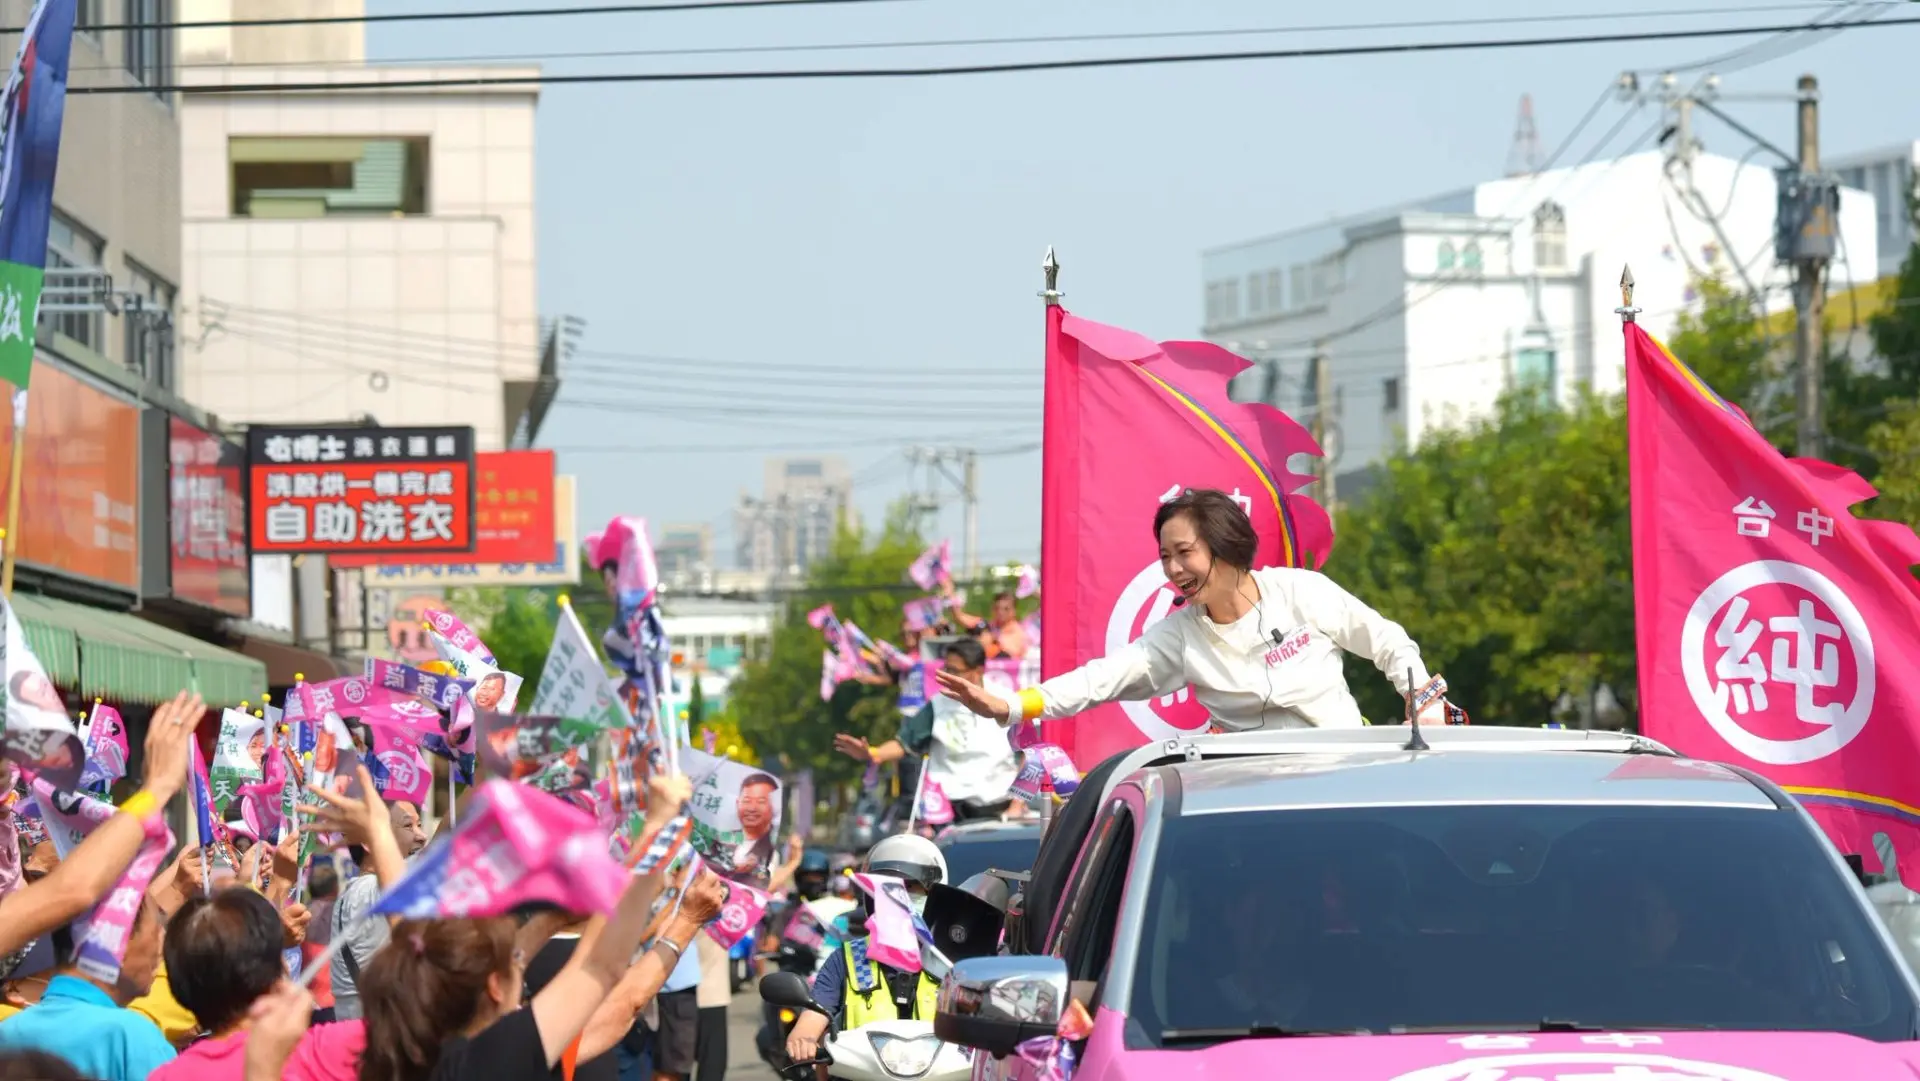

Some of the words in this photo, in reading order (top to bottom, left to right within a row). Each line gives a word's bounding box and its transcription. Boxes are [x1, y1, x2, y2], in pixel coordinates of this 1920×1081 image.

[266, 500, 453, 543] 自助洗衣
[1732, 495, 1834, 546] 台中
[1714, 596, 1843, 726] 純
[1446, 1033, 1664, 1049] 台中
